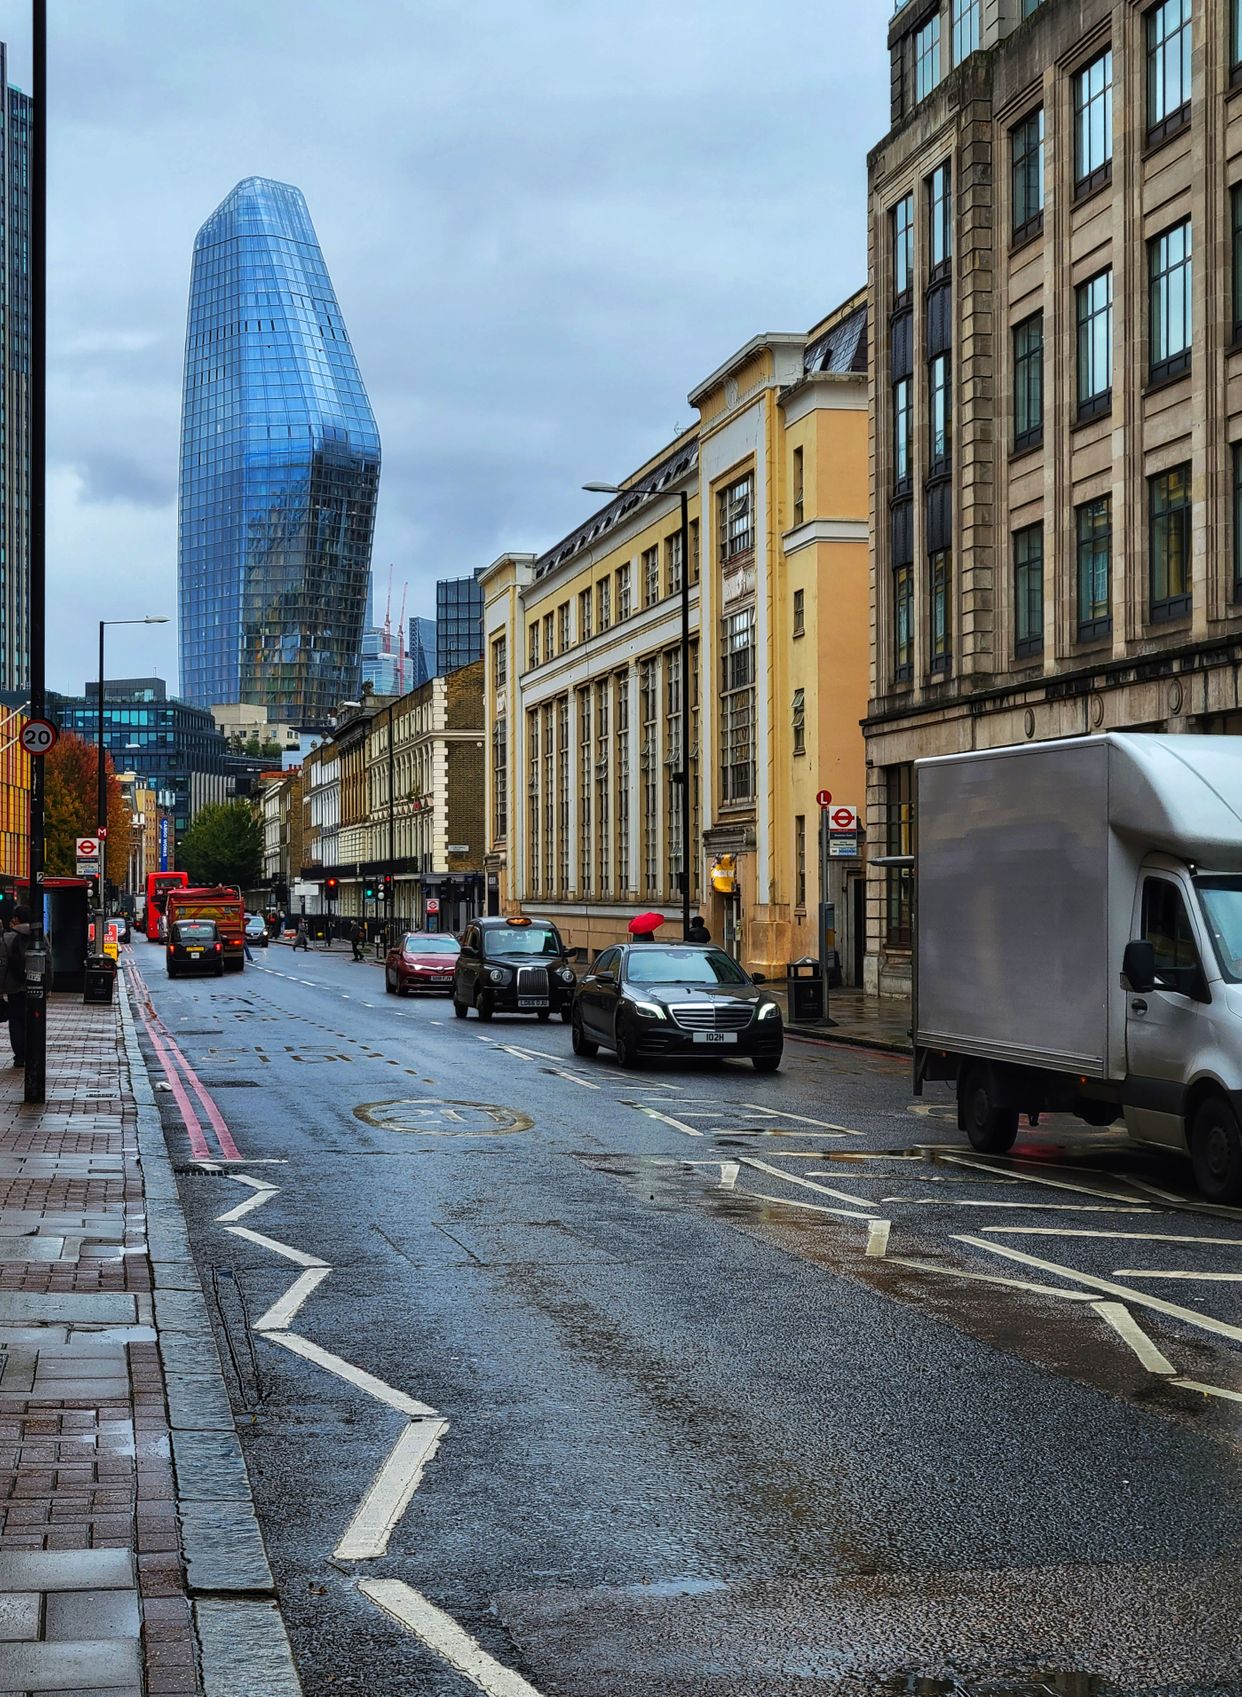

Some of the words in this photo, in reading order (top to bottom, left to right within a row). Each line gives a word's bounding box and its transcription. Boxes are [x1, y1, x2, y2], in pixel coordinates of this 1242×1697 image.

[25, 730, 50, 745] 20
[821, 792, 828, 804] L
[98, 828, 107, 836] M
